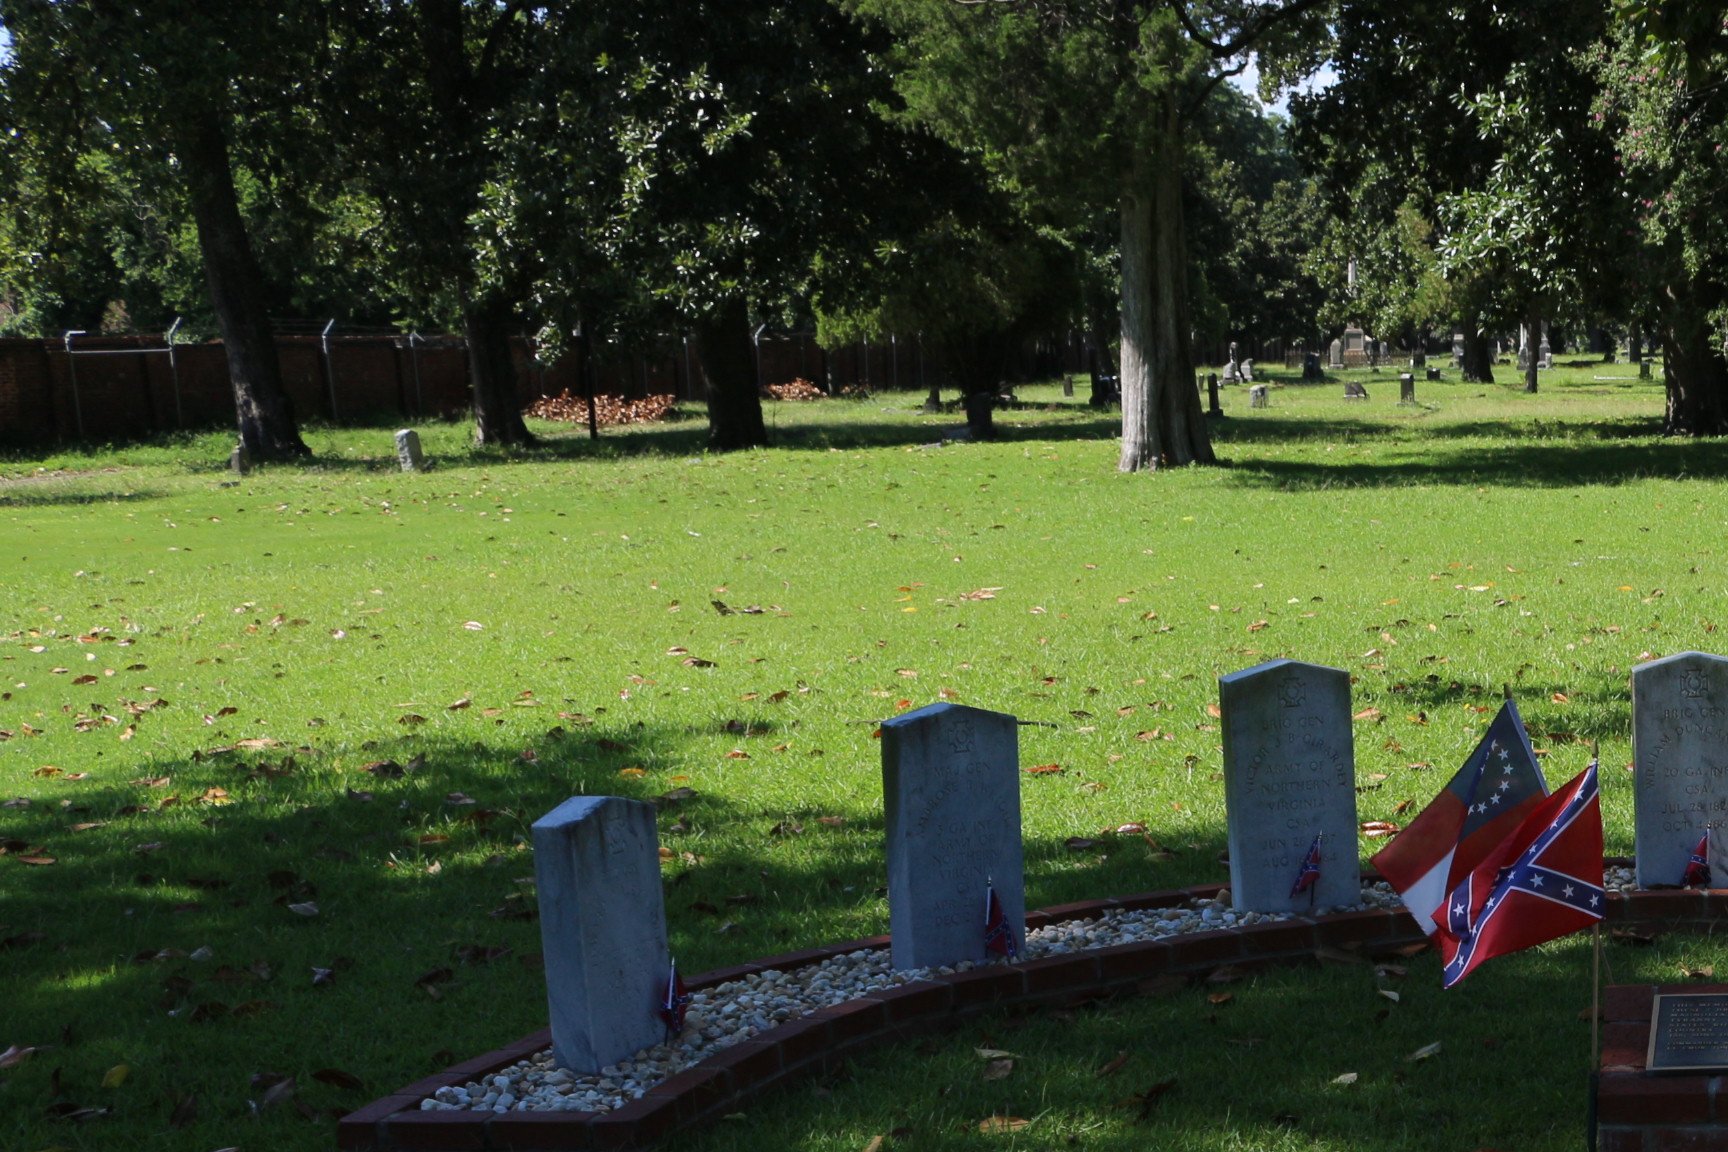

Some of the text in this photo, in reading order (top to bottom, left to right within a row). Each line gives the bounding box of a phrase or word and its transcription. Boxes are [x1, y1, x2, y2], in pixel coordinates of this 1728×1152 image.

[1664, 705, 1726, 719] BRIG GEN
[1299, 716, 1324, 728] GEN
[967, 761, 991, 775] GEN
[1309, 760, 1323, 771] OF
[1645, 734, 1671, 790] WILLIAM
[1663, 767, 1679, 778] 20
[1685, 766, 1703, 778] GA
[1261, 779, 1331, 793] NORTHERN
[1685, 785, 1709, 795] CSA
[1267, 798, 1325, 811] VIRGINIA
[1661, 803, 1685, 815] JUL
[1662, 820, 1688, 832] OCT
[1262, 839, 1287, 851] JUN
[1262, 856, 1289, 869] AUG
